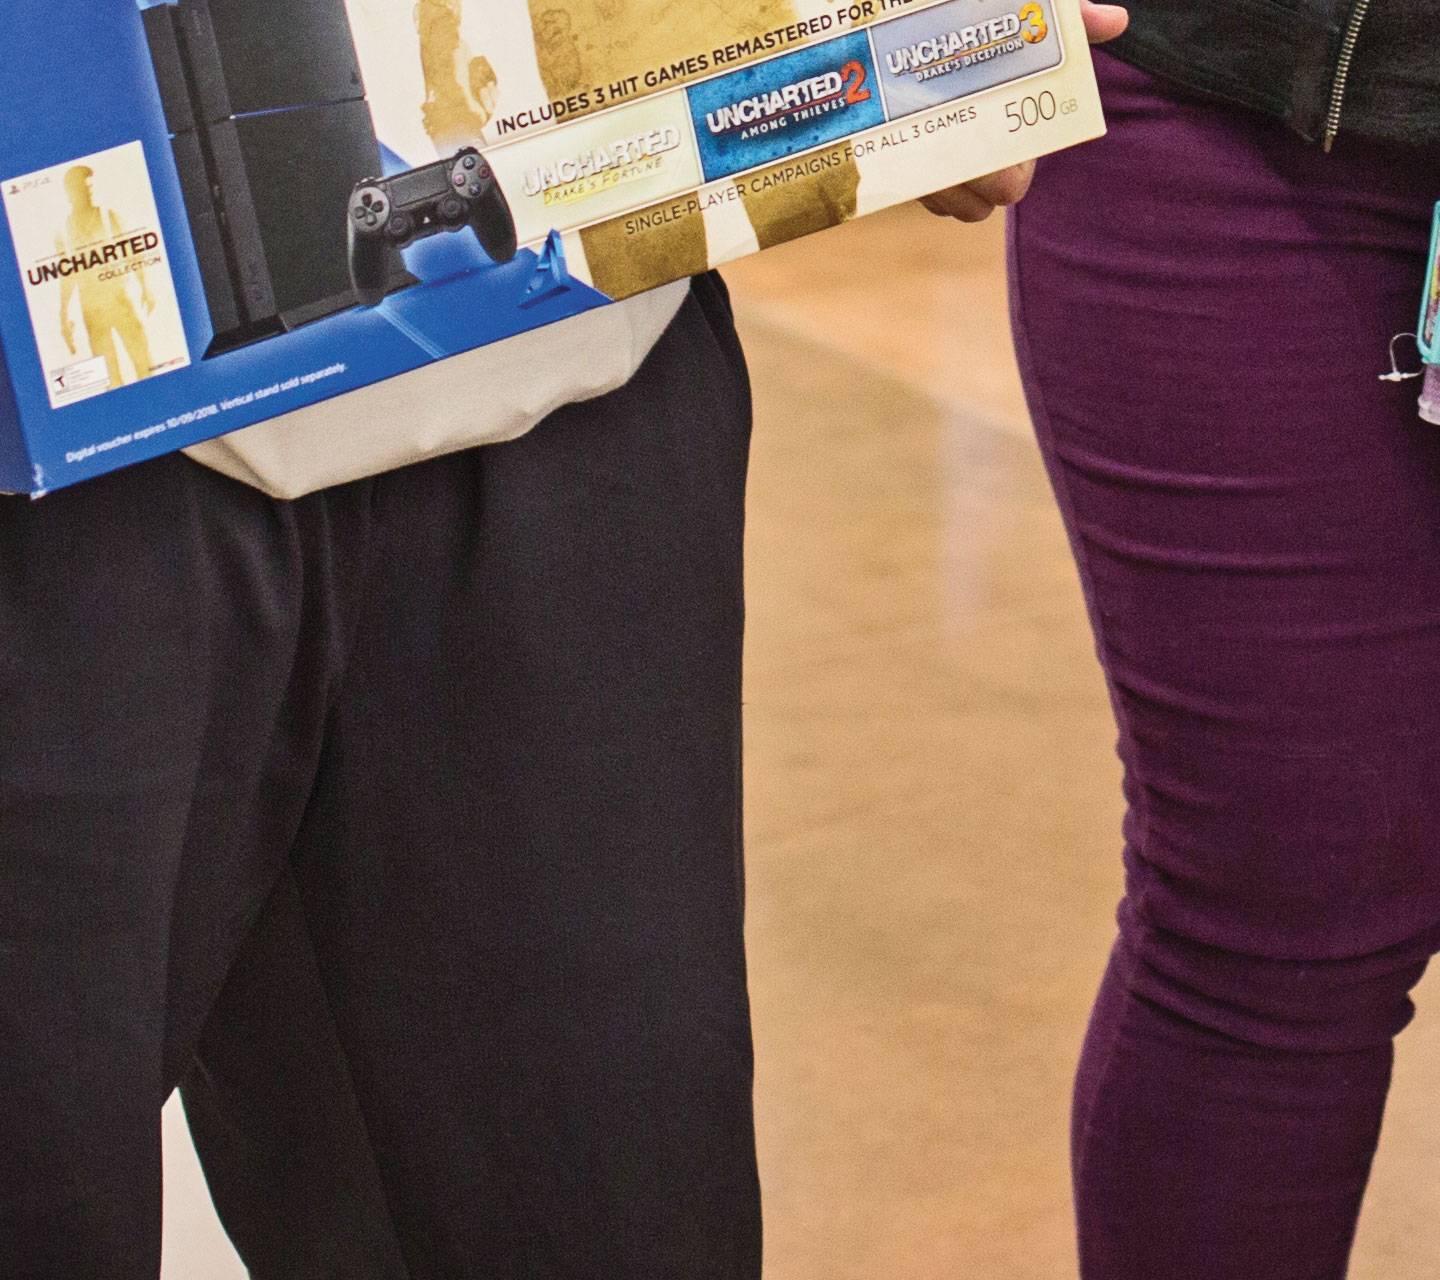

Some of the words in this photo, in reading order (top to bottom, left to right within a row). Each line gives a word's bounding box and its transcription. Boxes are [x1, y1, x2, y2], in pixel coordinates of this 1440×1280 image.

[495, 91, 590, 135] INCLUDES
[592, 86, 605, 104] 3
[608, 75, 638, 99] HIT
[643, 53, 709, 87] GAMES
[711, 13, 832, 66] REMASTERED
[838, 0, 875, 25] FOR
[884, 14, 1022, 76] UNCHARTED
[1018, 1, 1049, 45] 3
[705, 72, 844, 135] UNCHARTED
[840, 60, 872, 104] 2
[741, 118, 788, 140] AMONG
[791, 97, 847, 127] THIEVES
[1004, 90, 1058, 135] 500
[1060, 97, 1078, 116] GB
[520, 122, 682, 197] UNCHARTED
[624, 183, 747, 235] SINGLE-PLAYER
[751, 151, 842, 192] CAMPAIGNS
[842, 140, 876, 162] FOR
[878, 129, 908, 150] ALL
[910, 124, 922, 139] 3
[922, 106, 978, 135] GAMES
[26, 231, 160, 287] UNCHARTED
[97, 255, 162, 282] COLLECTION
[64, 444, 96, 464] Digital
[94, 433, 133, 452] voucher
[132, 422, 166, 441] expires
[253, 383, 280, 400] stand
[278, 377, 300, 391] sold
